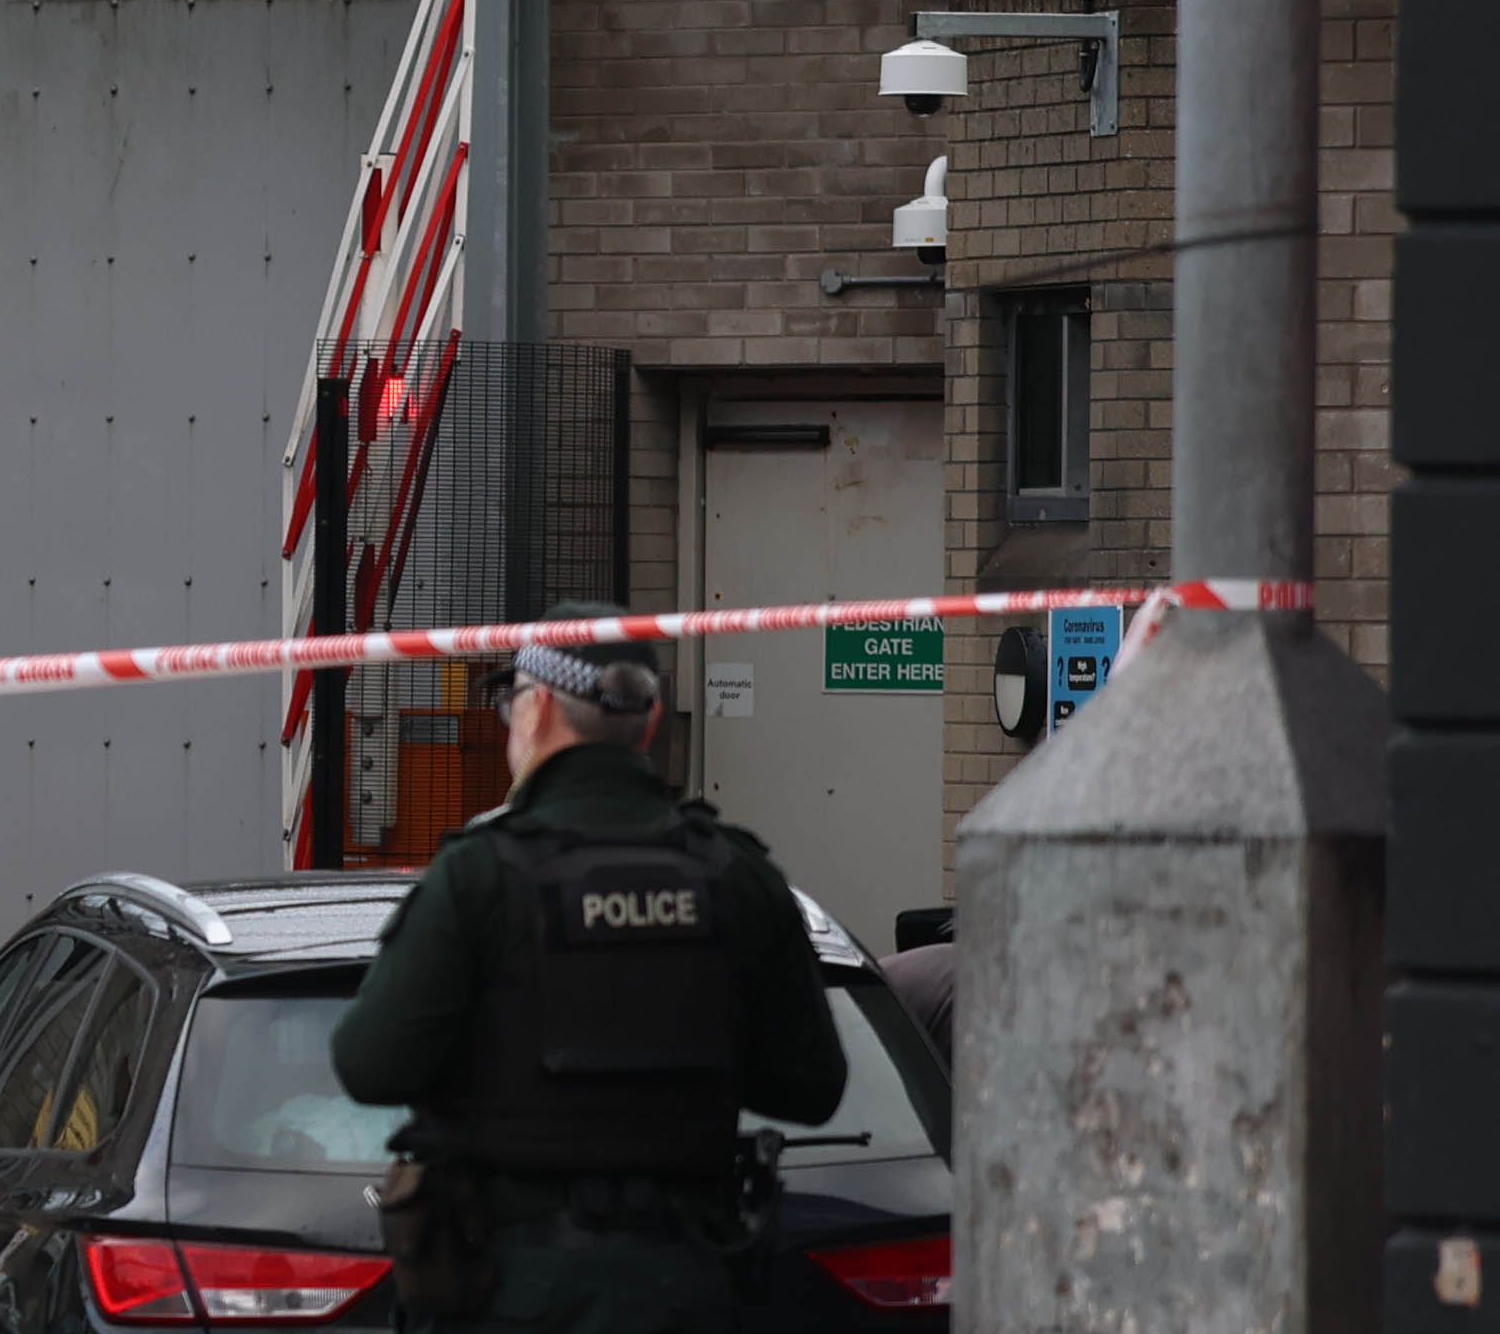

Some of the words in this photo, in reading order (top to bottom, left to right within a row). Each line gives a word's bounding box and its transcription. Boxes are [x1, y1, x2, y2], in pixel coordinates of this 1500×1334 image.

[1064, 618, 1105, 633] Coronavirus
[864, 638, 913, 655] GATE
[831, 663, 891, 680] ENTER
[897, 664, 944, 681] HERE
[707, 679, 752, 688] Automatic
[719, 691, 740, 700] door
[582, 889, 698, 928] POLICE
